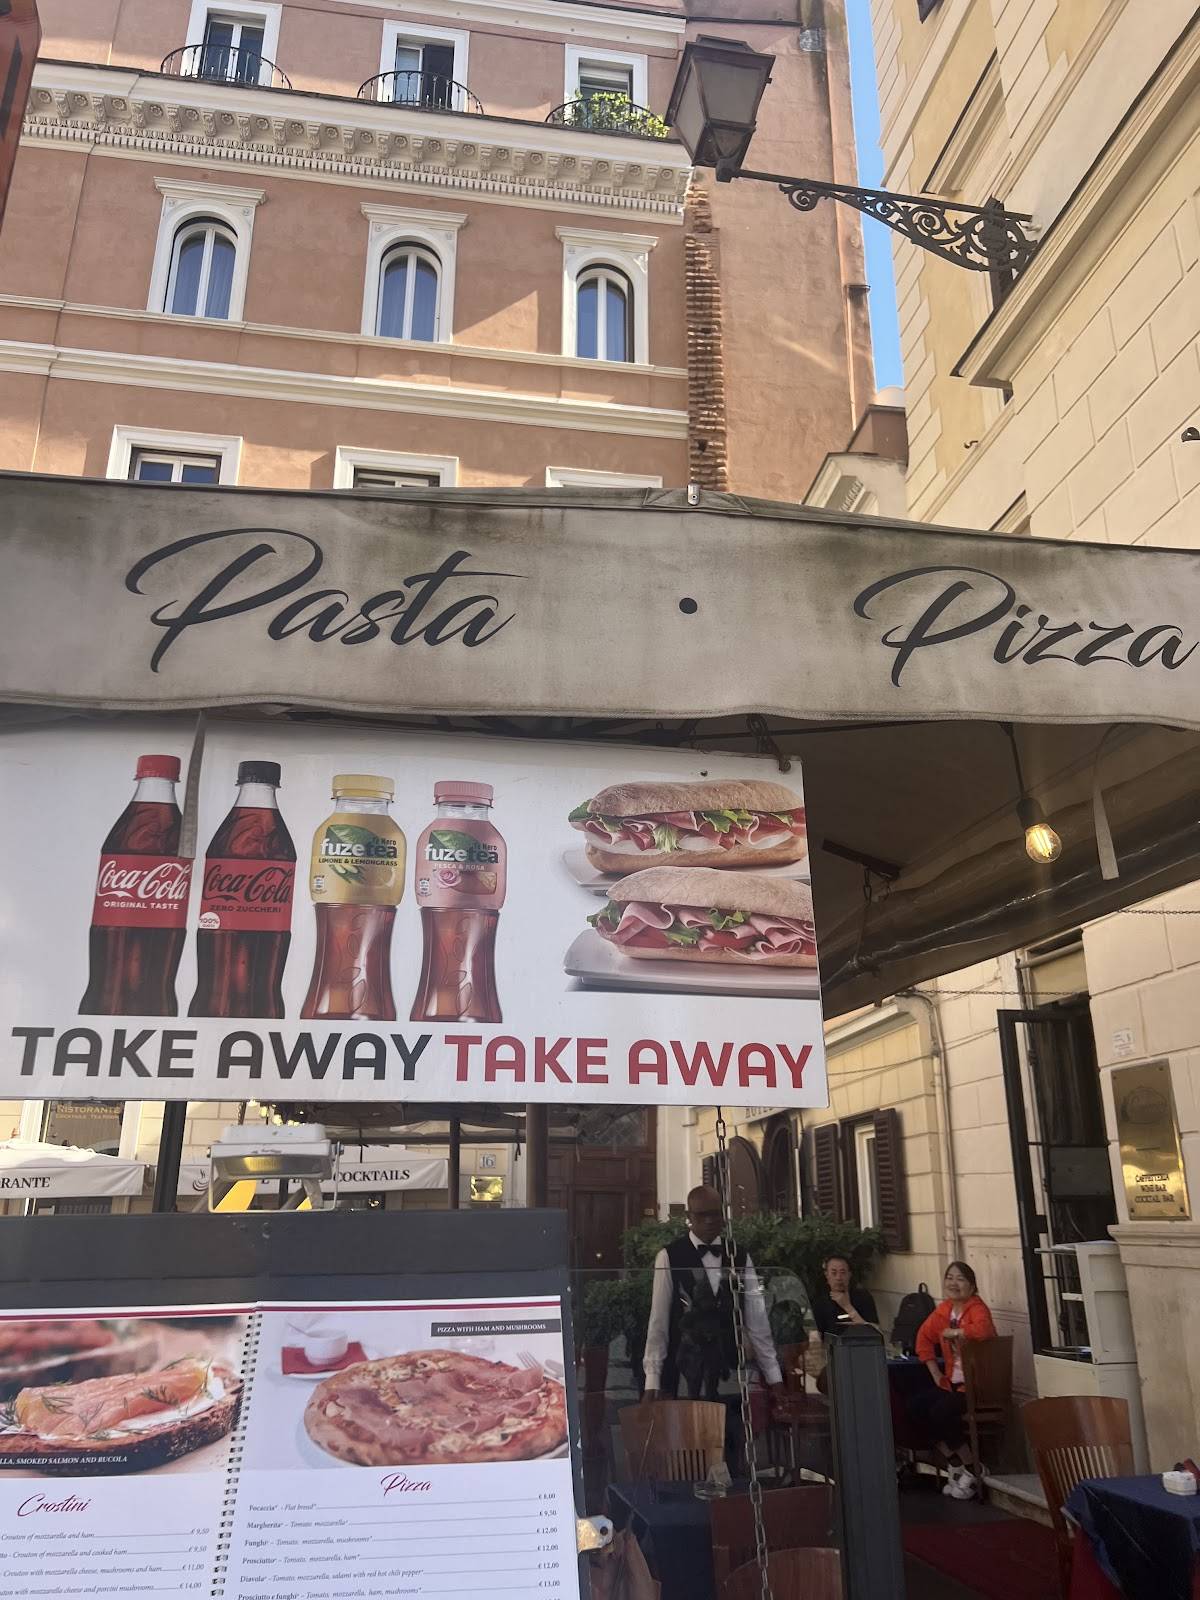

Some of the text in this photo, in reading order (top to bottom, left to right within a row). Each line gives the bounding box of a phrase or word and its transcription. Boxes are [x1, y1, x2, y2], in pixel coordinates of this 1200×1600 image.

[125, 527, 1200, 688] Pasta Pizza
[350, 859, 398, 867] LEMONGRASS
[97, 860, 192, 900] Coca-Cola
[203, 864, 295, 904] Coca-Cola
[103, 901, 180, 910] ORIGINAL TASTE
[209, 904, 281, 913] ZERO ZUCCHERI
[12, 1027, 813, 1089] TAKE AWAY TAKE AWAY
[482, 1155, 495, 1168] 16
[333, 1168, 411, 1183] COCKTAILS
[506, 1323, 546, 1331] MUSHROOMS
[16, 1457, 47, 1465] SMOKED
[380, 1472, 432, 1497] Pizza
[17, 1493, 92, 1517] Crostini
